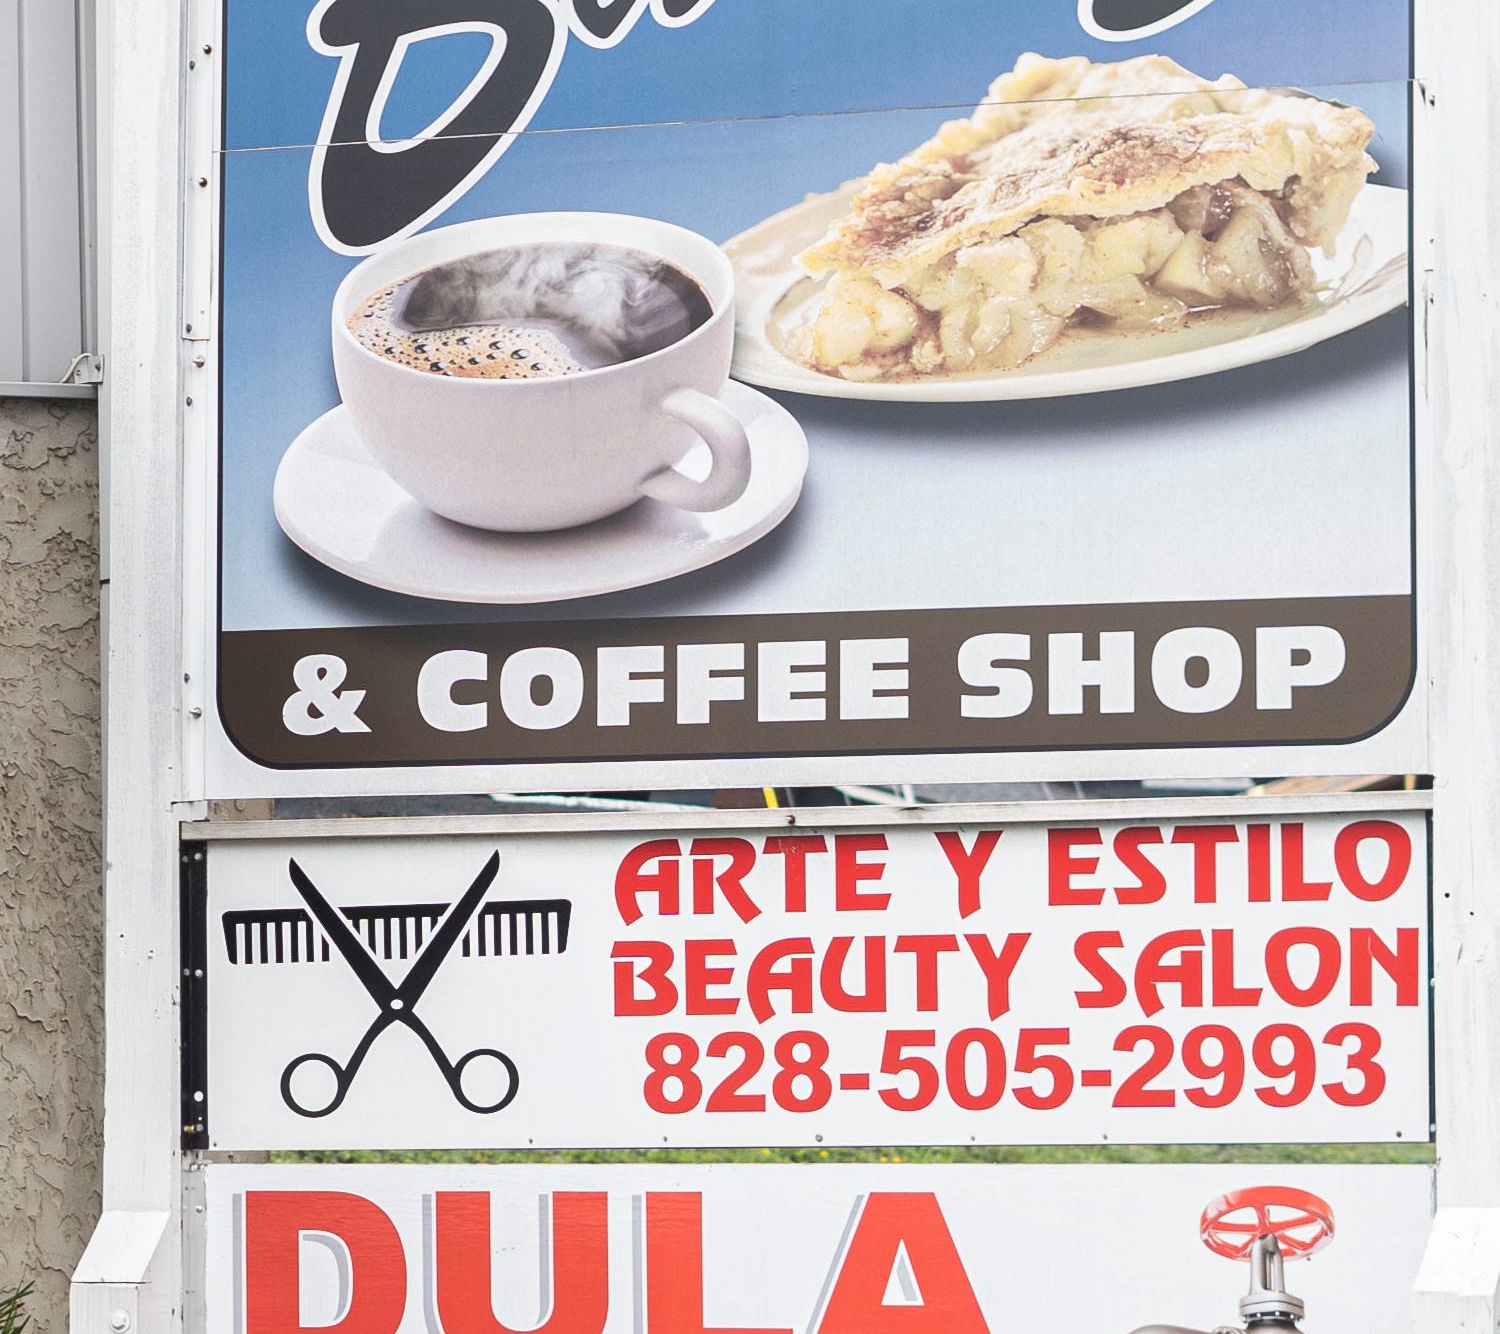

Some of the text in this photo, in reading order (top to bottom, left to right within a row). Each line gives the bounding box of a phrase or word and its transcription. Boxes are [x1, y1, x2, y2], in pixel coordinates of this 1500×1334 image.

[281, 624, 1347, 735] & COFFEE SHOP
[614, 819, 1412, 924] ARTE Y ESTILO
[611, 927, 1421, 1021] BEAUTY SALON
[643, 1022, 1388, 1115] 828-505-2993
